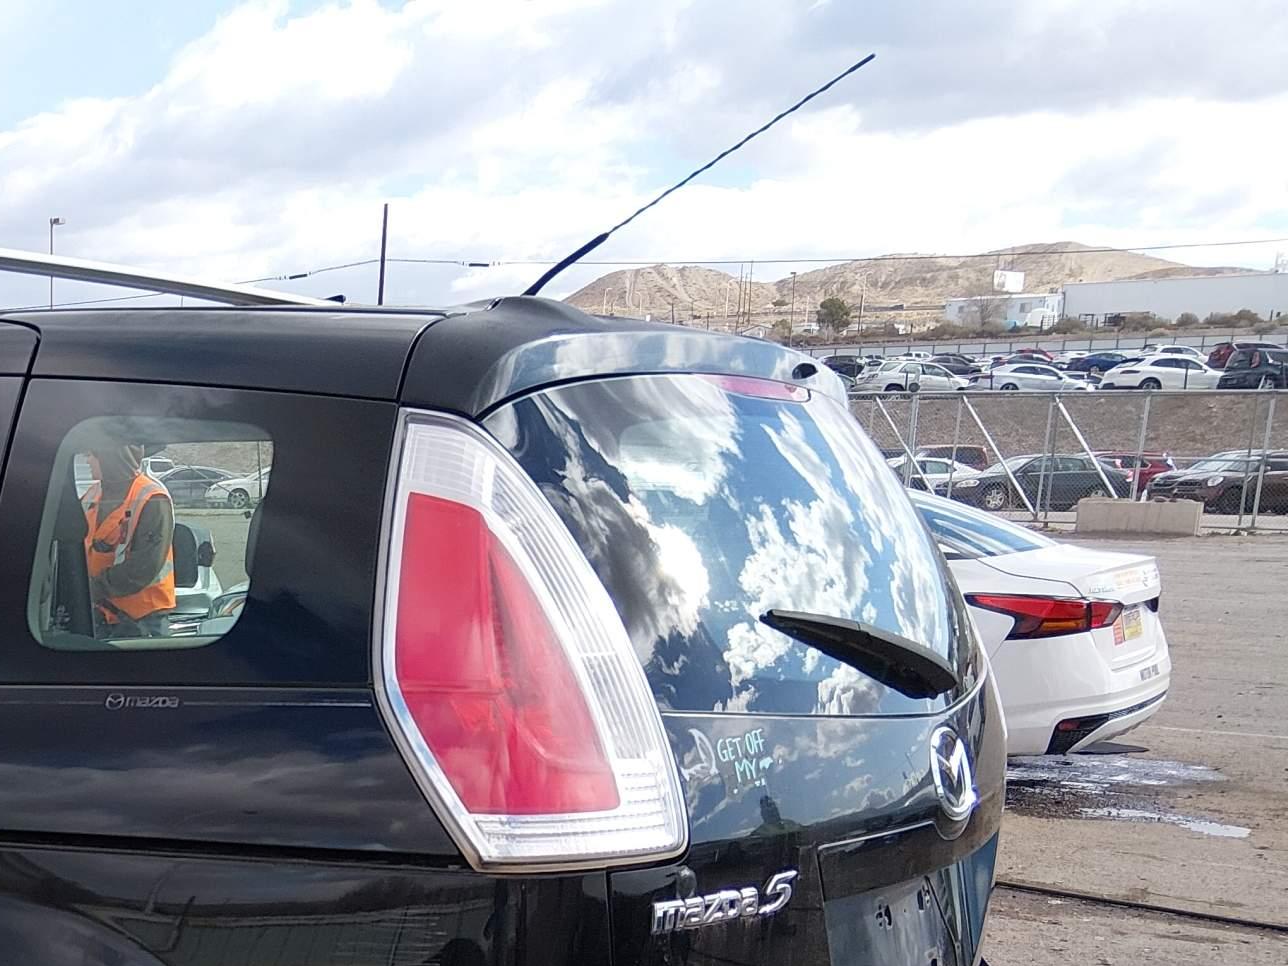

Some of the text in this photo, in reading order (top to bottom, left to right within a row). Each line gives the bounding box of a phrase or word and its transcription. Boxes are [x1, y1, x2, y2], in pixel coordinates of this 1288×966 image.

[717, 728, 765, 762] GET OFF
[734, 758, 757, 783] MY
